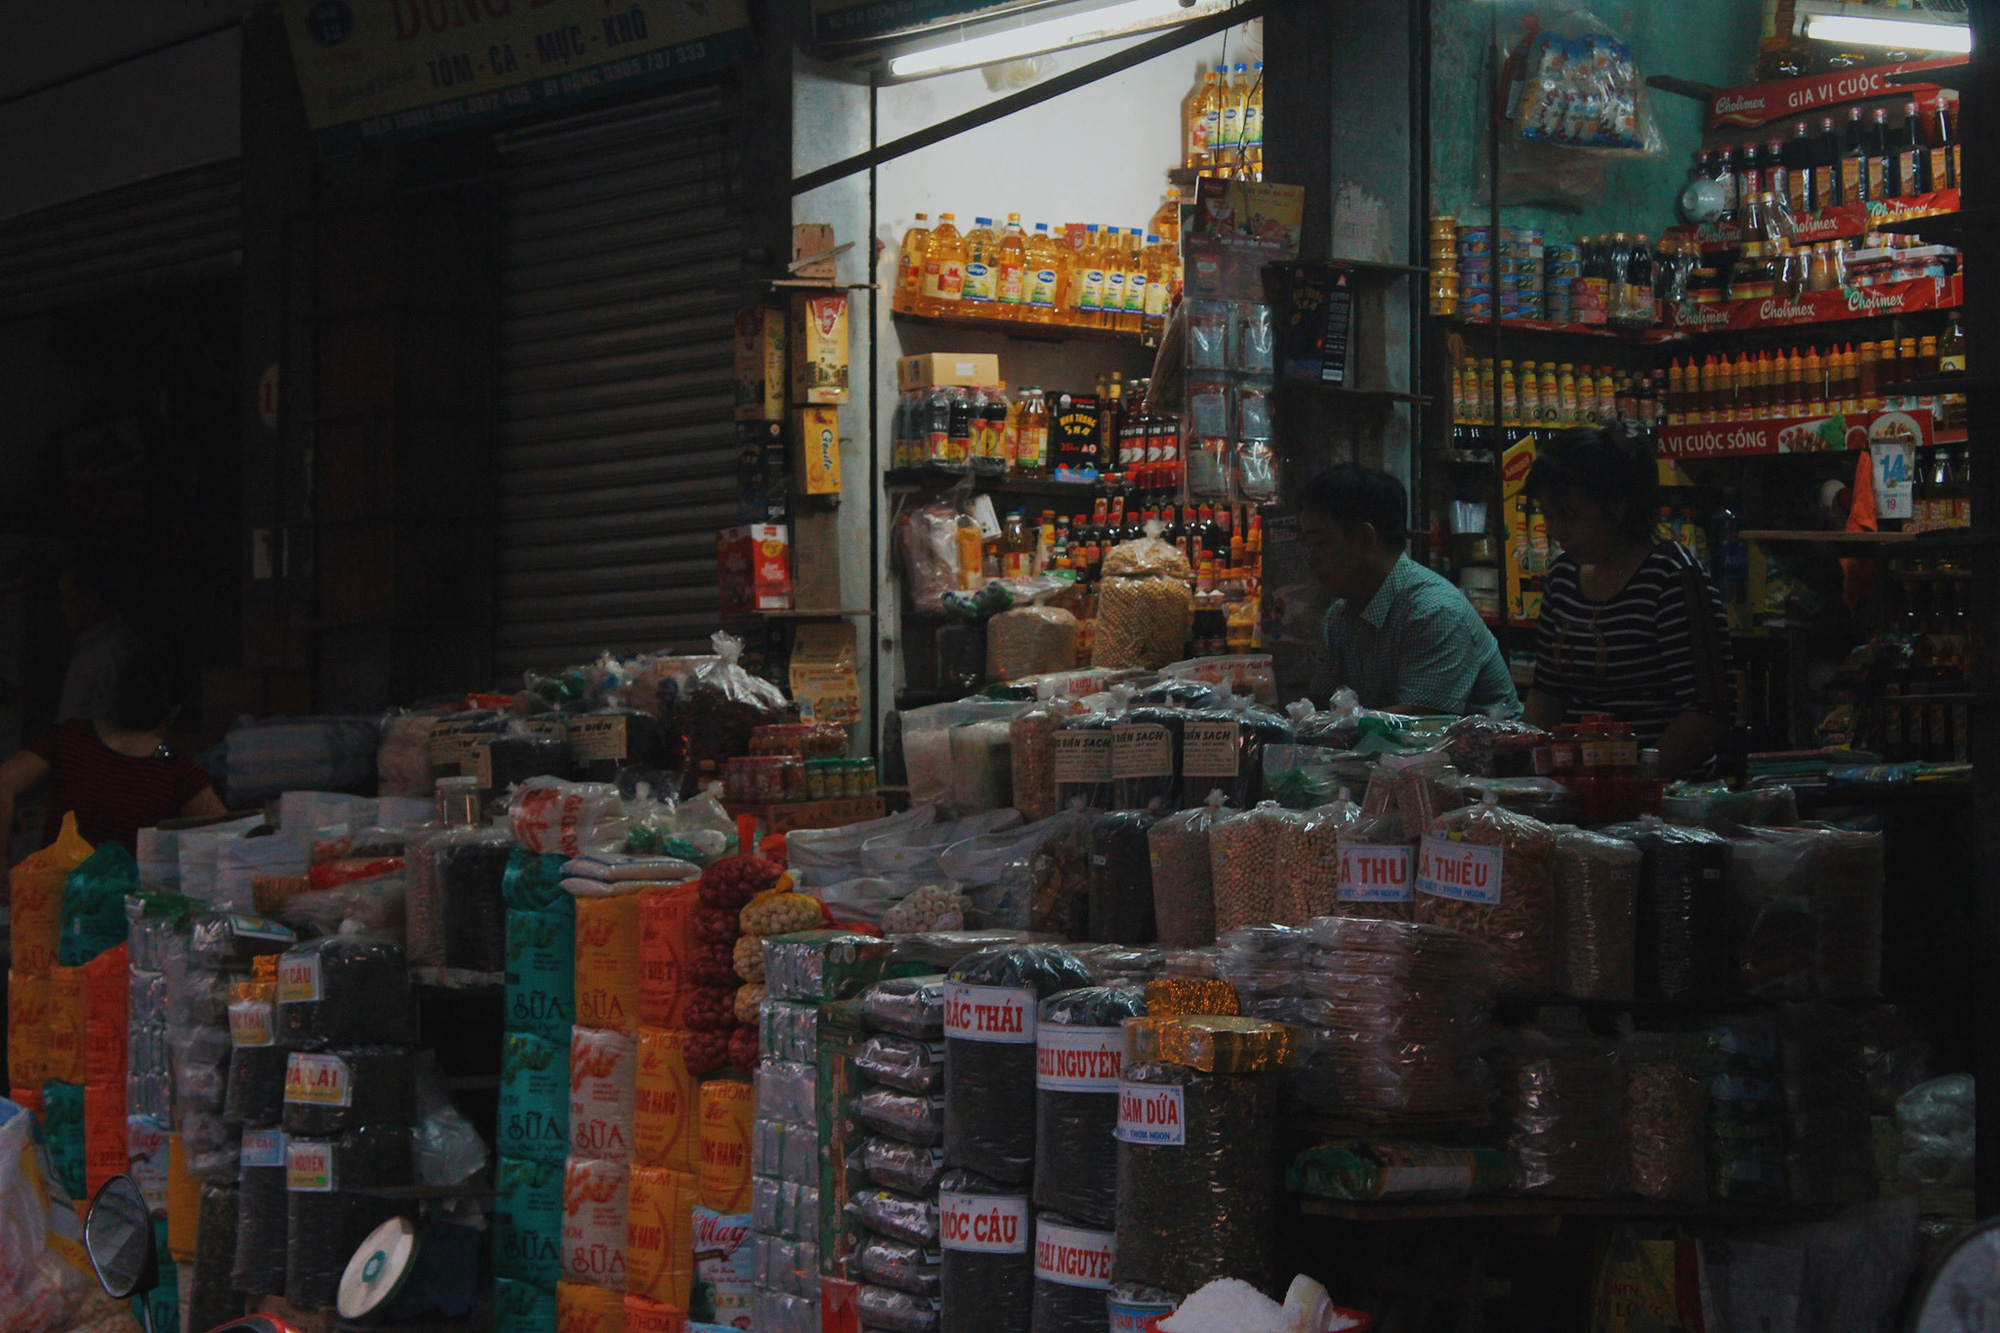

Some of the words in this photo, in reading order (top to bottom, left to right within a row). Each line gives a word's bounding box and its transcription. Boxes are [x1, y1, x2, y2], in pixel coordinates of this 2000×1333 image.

[426, 53, 474, 88] TÔM
[489, 37, 519, 75] CÁ
[535, 25, 586, 65] MỰC
[602, 4, 648, 47] KHÔ
[1715, 95, 1766, 114] Cholimex
[1788, 89, 1815, 108] GIA
[1818, 84, 1834, 103] VỊ
[1838, 73, 1880, 97] CUỘC
[1792, 212, 1838, 234] holimex
[1760, 299, 1816, 320] Cholimex
[1848, 290, 1905, 311] Cholimex
[1668, 437, 1684, 457] VỊ
[1686, 431, 1725, 456] CUỘC
[1727, 429, 1767, 449] SỐNG
[1880, 454, 1905, 483] 14
[1886, 498, 1897, 510] 19
[1357, 858, 1407, 885] THU
[1435, 851, 1488, 888] THIỀU
[513, 990, 566, 1020] SỮA
[580, 988, 624, 1019] SỮA
[945, 990, 971, 1030] BẮC
[974, 998, 1024, 1034] THÁI
[1057, 1043, 1122, 1079] NGUYÊN
[1146, 1093, 1178, 1125] DỨA
[508, 1110, 563, 1141] SỮA
[576, 1118, 627, 1150] SỮA
[699, 1215, 750, 1253] May
[973, 1207, 1019, 1244] CÂU
[504, 1230, 559, 1261] SỮA
[572, 1243, 628, 1274] SỮA
[1057, 1244, 1112, 1280] NGUYÊ
